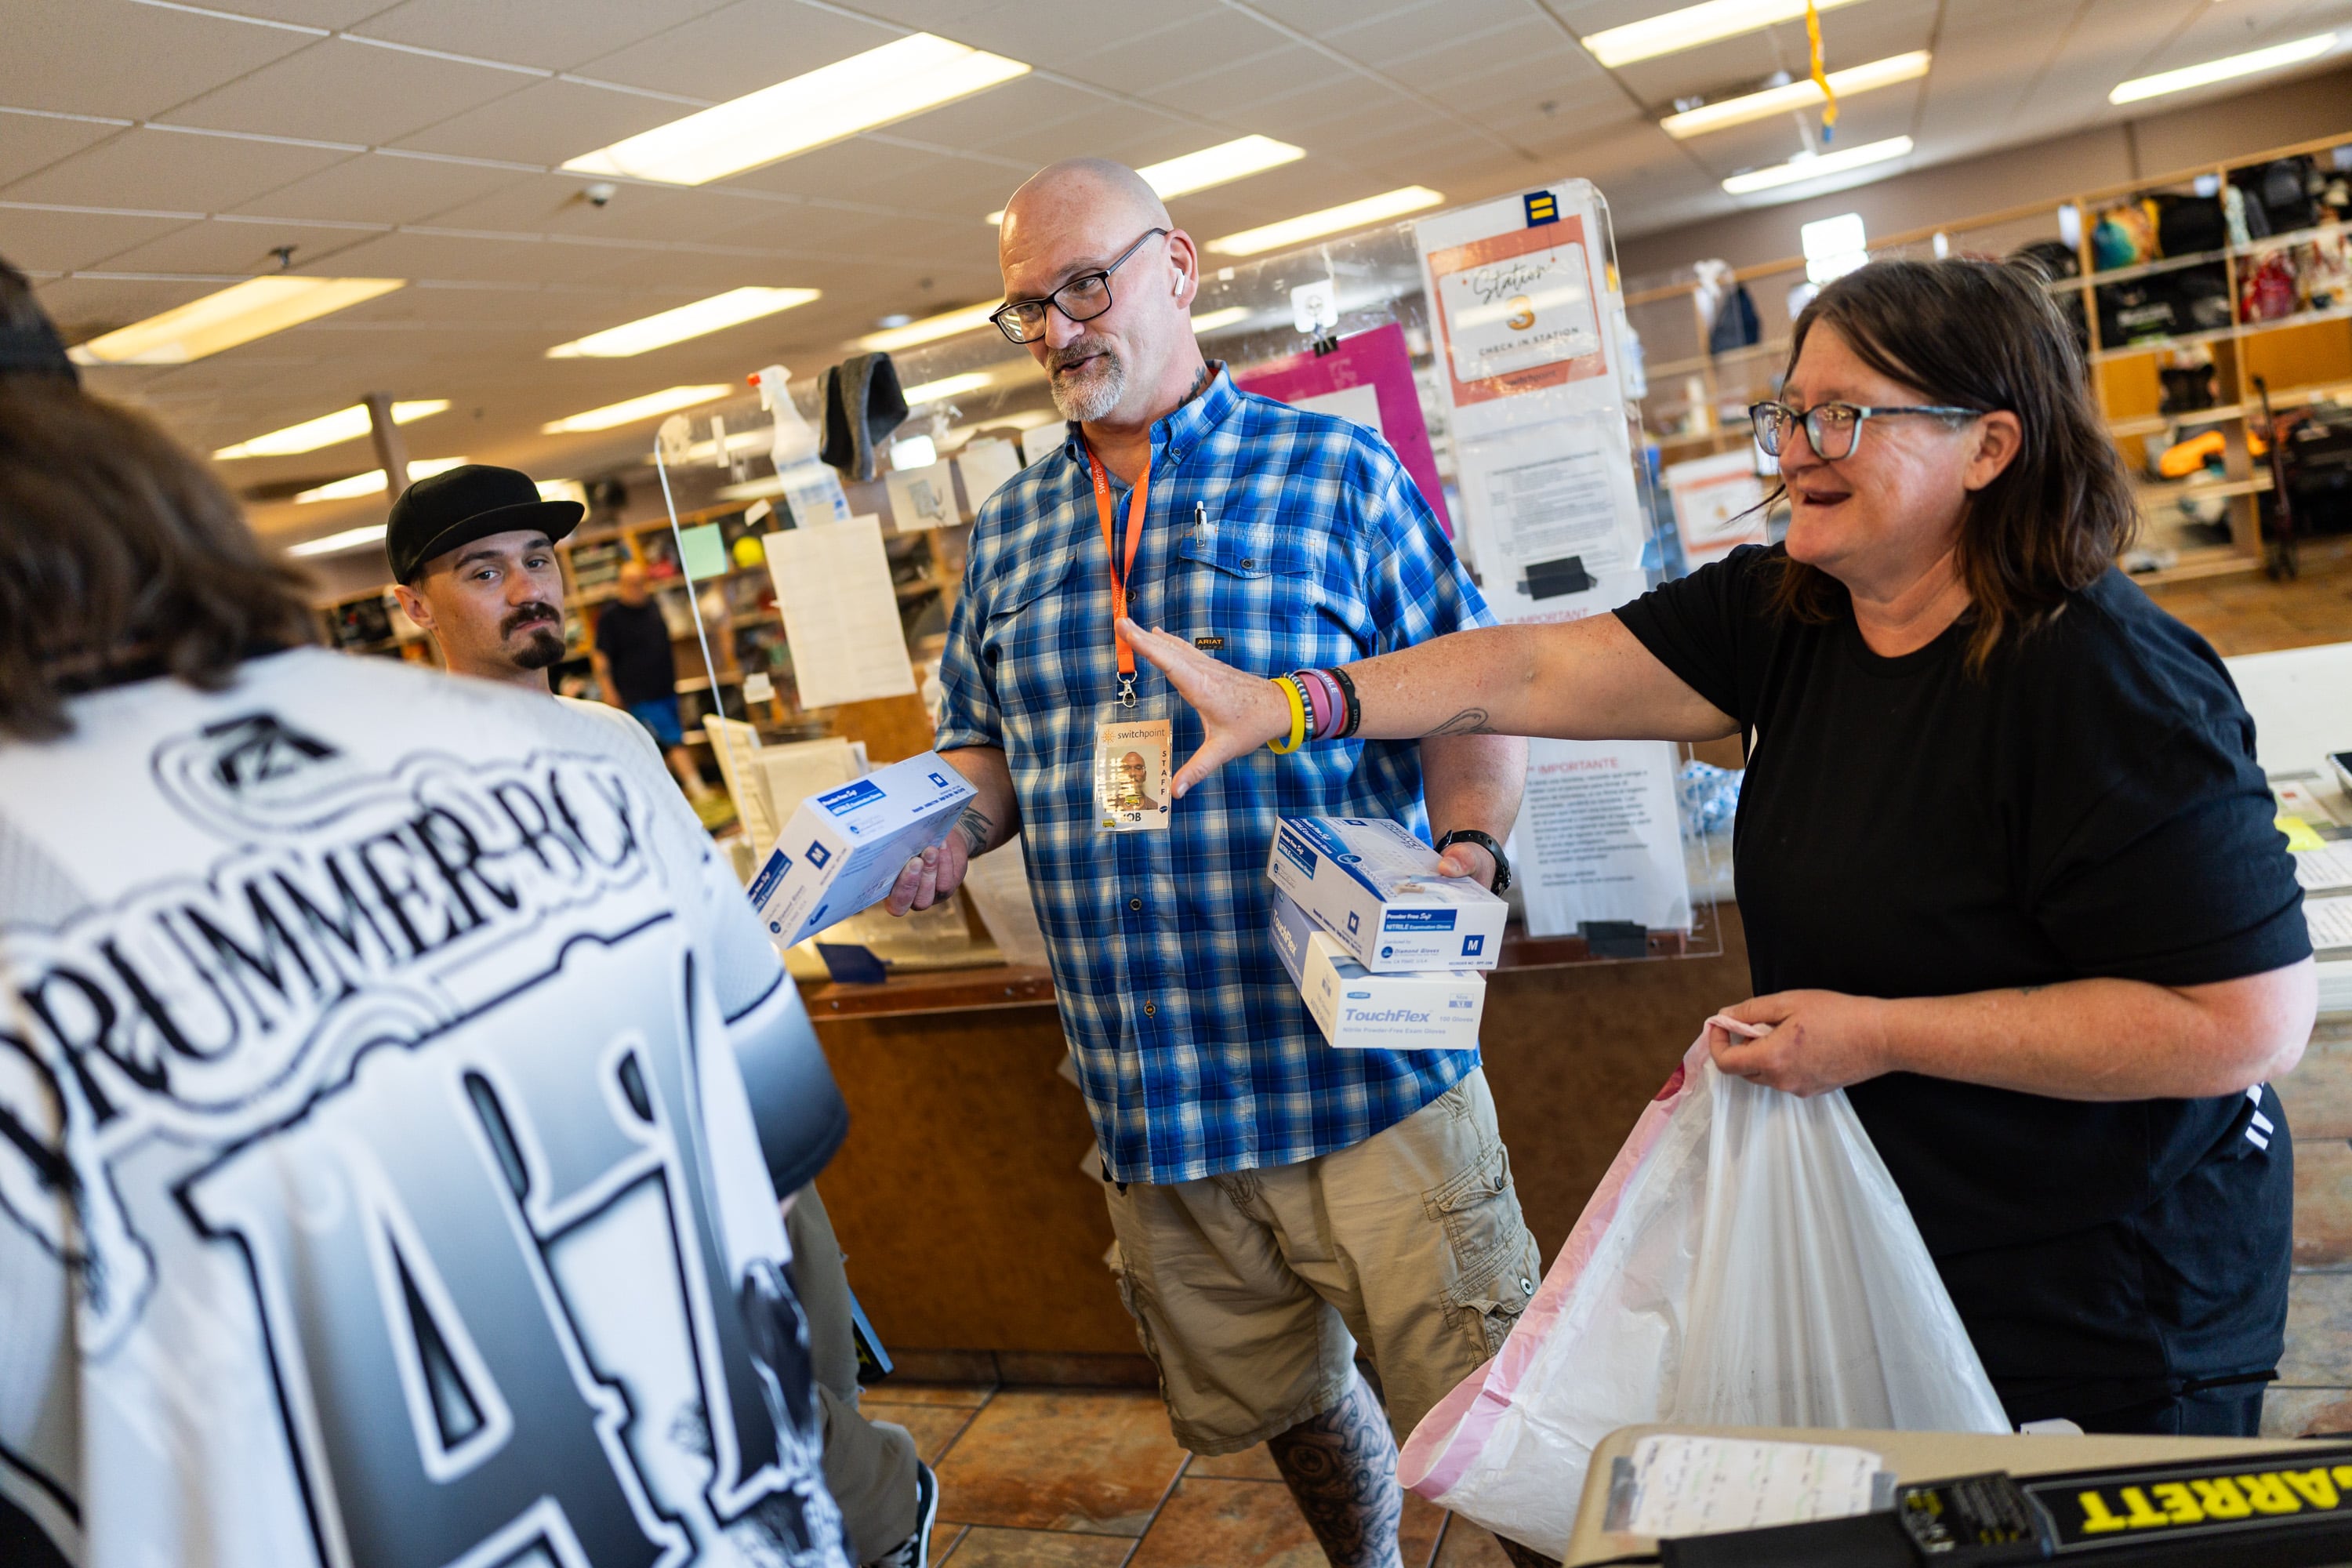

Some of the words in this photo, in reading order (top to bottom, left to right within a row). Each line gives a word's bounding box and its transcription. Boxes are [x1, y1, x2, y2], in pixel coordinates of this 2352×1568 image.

[1506, 295, 1535, 330] 3
[1479, 343, 1513, 357] CHECK
[1533, 327, 1579, 343] STATION
[1117, 728, 1166, 739] switchpoint
[1538, 757, 1619, 775] IMPORTANTE
[811, 847, 826, 862] M
[1350, 916, 1356, 929] M
[1273, 909, 1298, 957] TouchFlex
[1467, 940, 1479, 951] M
[1345, 1008, 1431, 1023] TouchFlex
